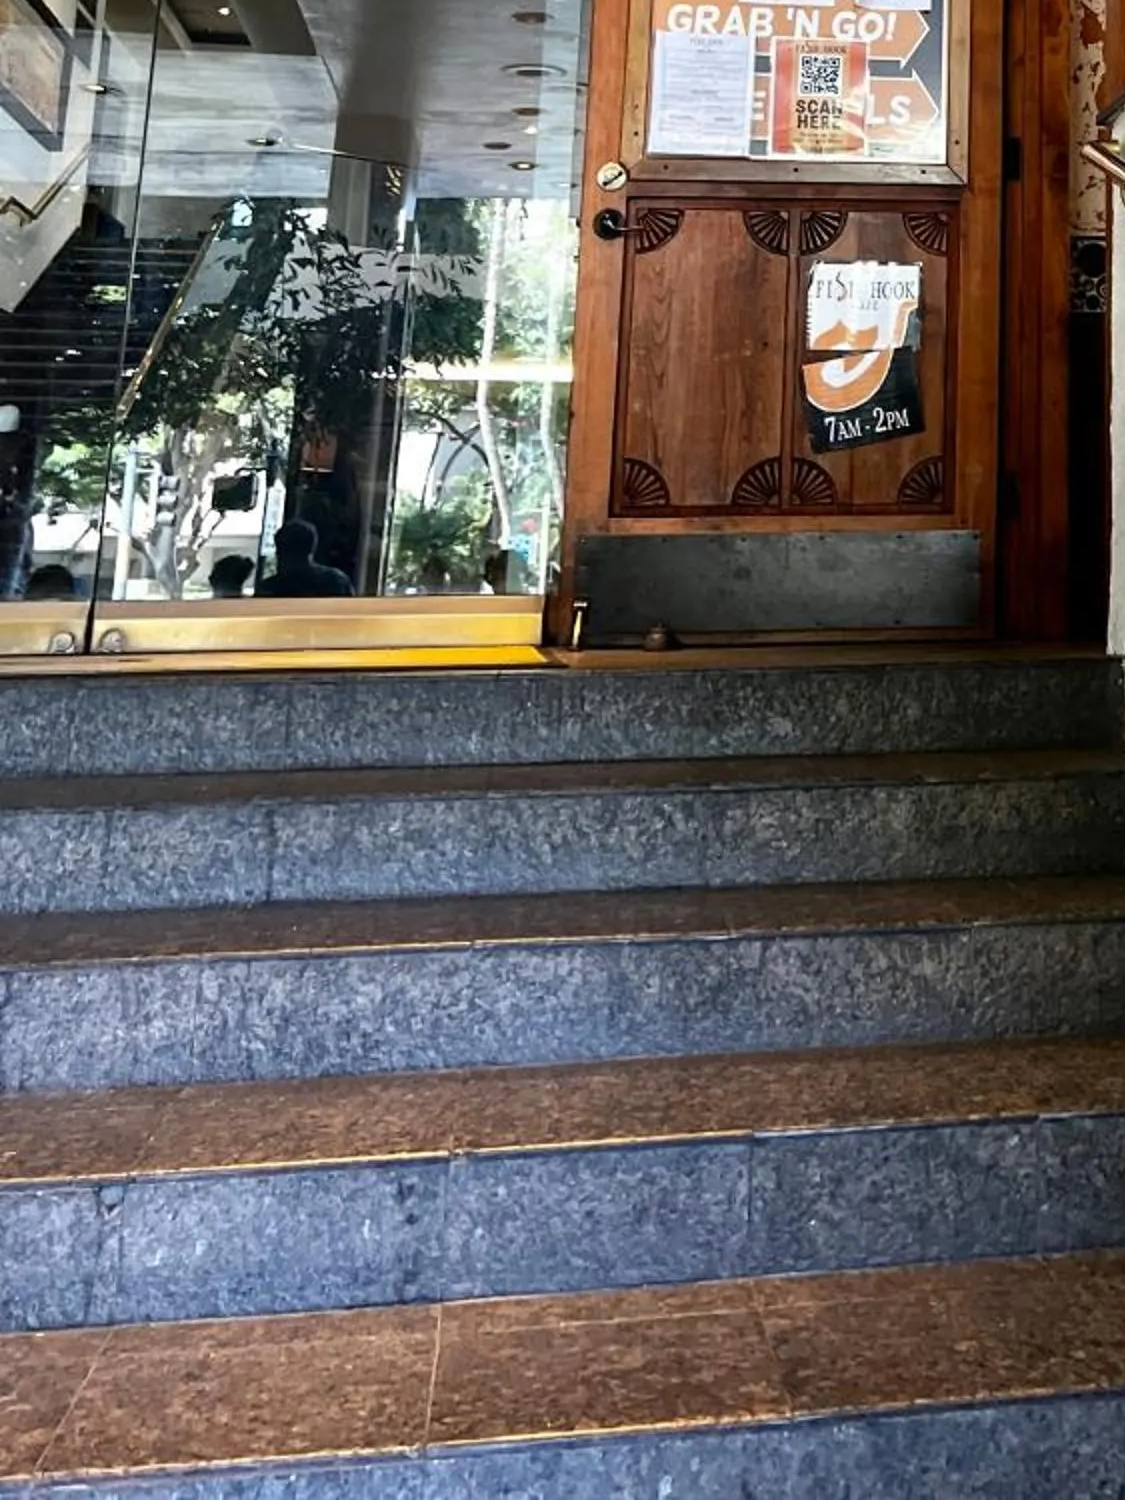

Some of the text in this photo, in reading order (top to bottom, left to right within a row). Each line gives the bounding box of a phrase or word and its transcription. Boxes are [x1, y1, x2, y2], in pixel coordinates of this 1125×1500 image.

[667, 3, 773, 38] GRAB
[832, 10, 898, 42] GO!
[795, 99, 843, 115] SCAN
[797, 114, 842, 130] HERE
[824, 415, 863, 443] 7AM
[872, 406, 911, 433] 2PM
